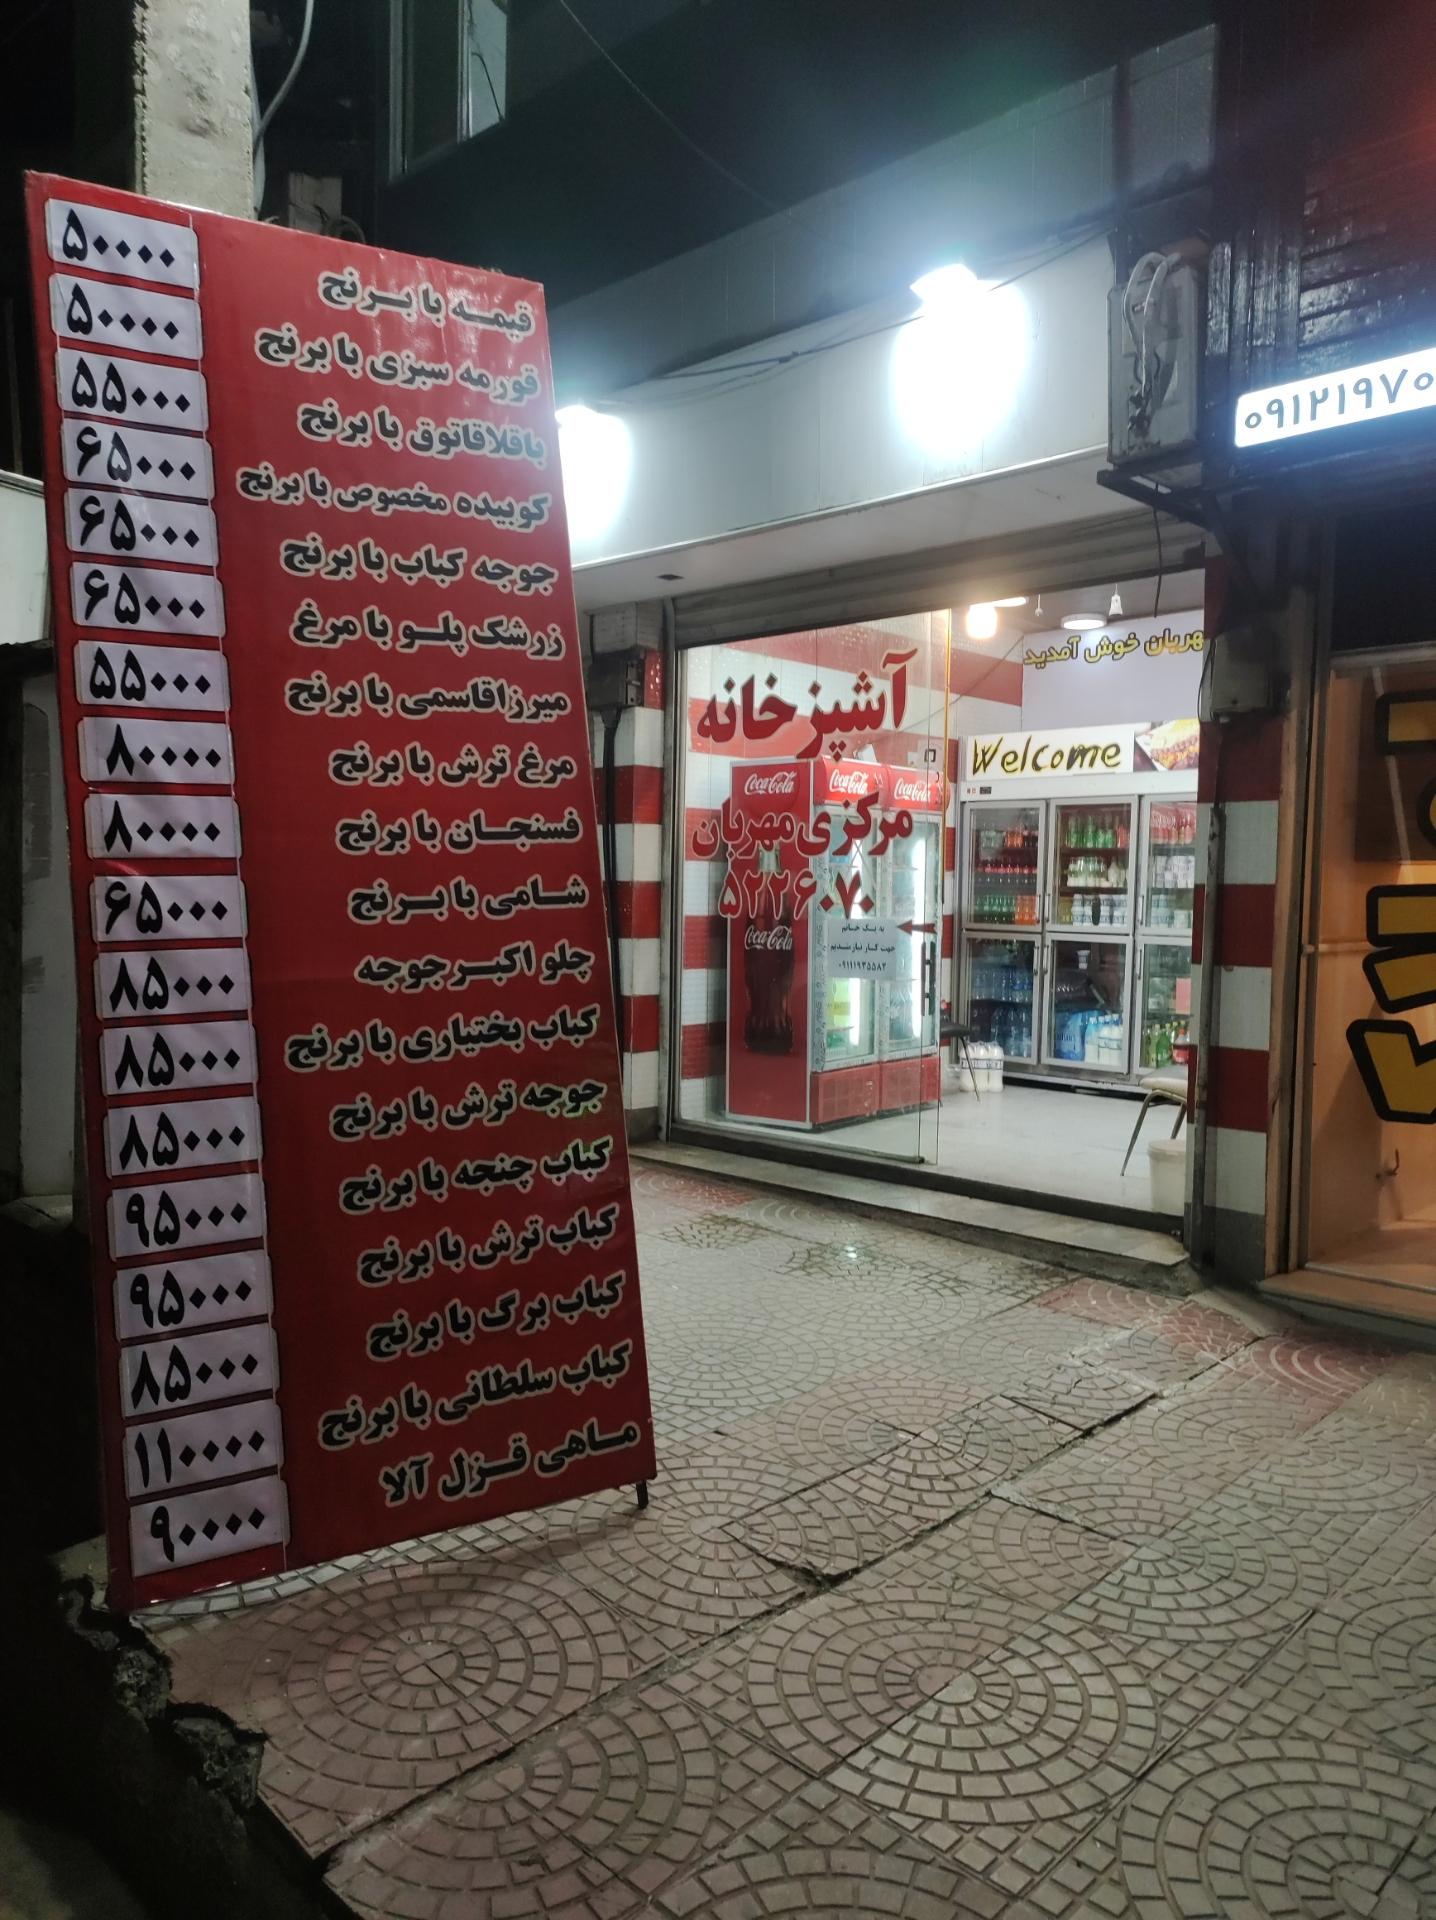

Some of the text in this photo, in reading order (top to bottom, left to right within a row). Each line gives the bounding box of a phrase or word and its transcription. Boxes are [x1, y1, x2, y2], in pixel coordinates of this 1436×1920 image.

[62, 209, 175, 269] ۵۰۰۰۰
[67, 283, 179, 339] ۵۰۰۰۰
[321, 268, 533, 338] قیمه با برنج
[258, 326, 327, 371] برنج
[337, 336, 360, 375] با
[370, 351, 449, 386] سبزی
[71, 357, 191, 413] ۵۵۰۰۰
[300, 401, 368, 443] برنج
[378, 410, 401, 447] با
[76, 427, 196, 482] ۶۵۰۰۰
[80, 497, 200, 551] ۶۵۰۰۰
[240, 465, 549, 529] کوبیده مخصوص با برنج
[283, 535, 556, 592] جوجه کباب با برنج
[83, 569, 205, 624] ۶۵۰۰۰
[292, 601, 563, 657] زرشک پلو با مرغ
[1023, 628, 1204, 669] هربان خوش آمدید
[89, 649, 211, 701] ۵۵۰۰۰
[288, 673, 358, 713] برنج
[366, 677, 390, 715] با
[106, 724, 222, 776] ۸۰۰۰۰
[332, 744, 574, 784] مرغ ترش با برنج
[972, 735, 1122, 777] Welcome
[104, 801, 221, 852] ۸۰۰۰۰
[338, 810, 580, 851] فسنجان با برنج
[691, 792, 913, 859] مرکزی مهربان
[105, 881, 227, 934] ۶۵۰۰۰
[351, 877, 586, 920] شامی با برنج
[718, 869, 875, 920] ۵۲۲۶۰۷۰
[109, 957, 234, 1012] ۸۵۰۰۰
[358, 942, 592, 991] چلو اکبر جوجه
[114, 1033, 240, 1090] ۸۵۰۰۰
[287, 1005, 597, 1069] کباب بختیاری با برنج
[331, 1080, 605, 1139] جوجه ترش با برنج
[119, 1112, 245, 1170] ۸۵۰۰۰
[342, 1137, 612, 1212] کباب چنجه با برنج
[125, 1190, 247, 1248] ۹۵۰۰۰
[359, 1204, 618, 1285] کباب ترش با برنج
[129, 1270, 252, 1328] ۹۵۰۰۰
[368, 1272, 624, 1359] کباب برگ با برنج
[132, 1345, 258, 1409] ۸۵۰۰۰
[322, 1341, 631, 1447] کباب سلطانی با برنج
[134, 1427, 264, 1488] ۱۱۰۰۰۰
[441, 1436, 527, 1498] قزل
[537, 1420, 638, 1473] ماهی
[150, 1505, 265, 1562] ۹۰۰۰۰
